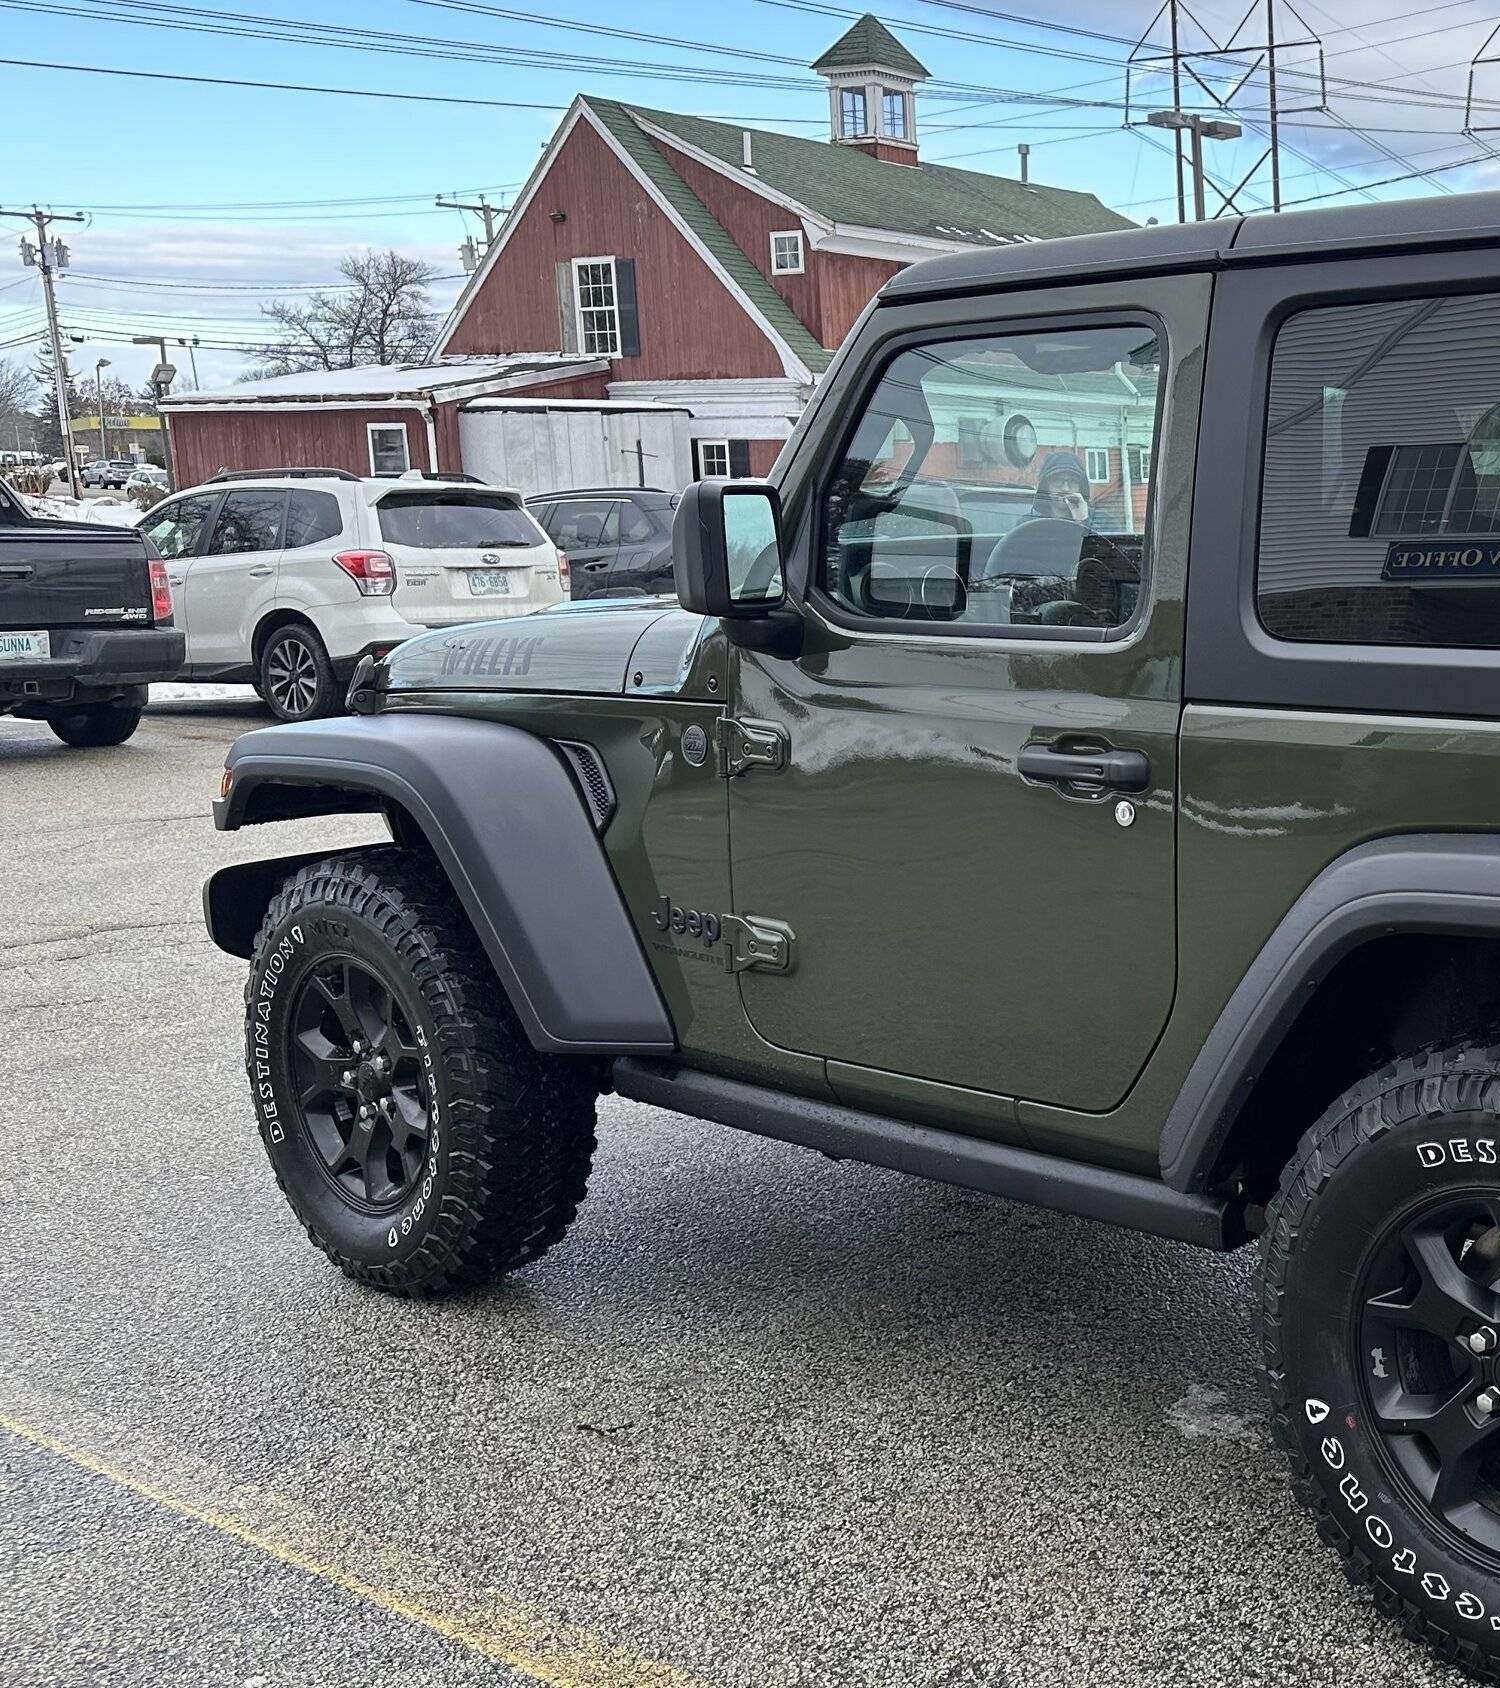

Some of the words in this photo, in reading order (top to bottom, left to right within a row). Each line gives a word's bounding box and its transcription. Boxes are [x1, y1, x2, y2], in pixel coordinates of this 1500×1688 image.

[84, 607, 148, 616] RIDGELINE
[120, 613, 148, 621] 4WD
[440, 637, 545, 676] WILLYS
[650, 895, 721, 947] Jeep
[254, 935, 300, 1144] DESTINATION
